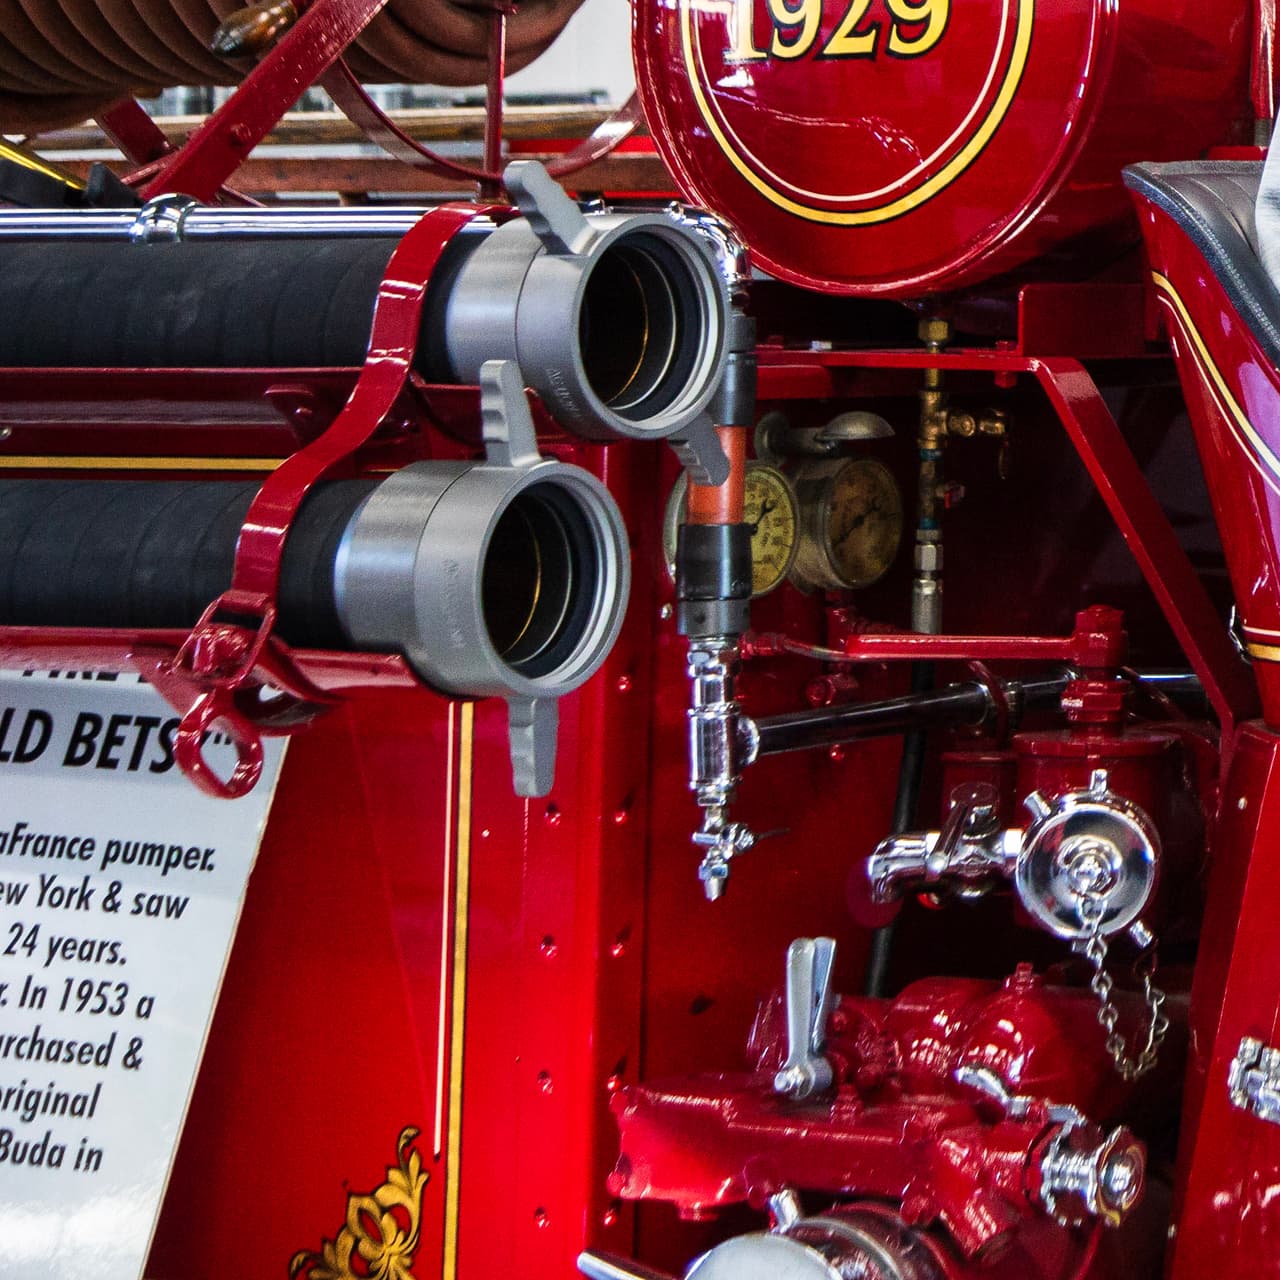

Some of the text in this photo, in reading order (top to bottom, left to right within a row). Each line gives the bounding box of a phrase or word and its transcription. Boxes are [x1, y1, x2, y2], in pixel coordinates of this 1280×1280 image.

[101, 839, 215, 876] pumper.
[37, 873, 96, 911] York
[102, 880, 122, 914] &
[131, 891, 189, 920] saw
[4, 922, 126, 968] 24 years.
[19, 974, 47, 1009] In
[59, 977, 129, 1017] 1953
[136, 995, 154, 1019] a
[0, 1024, 143, 1071] rchased &
[0, 1079, 102, 1123] riginal
[0, 1128, 103, 1172] Buda in
